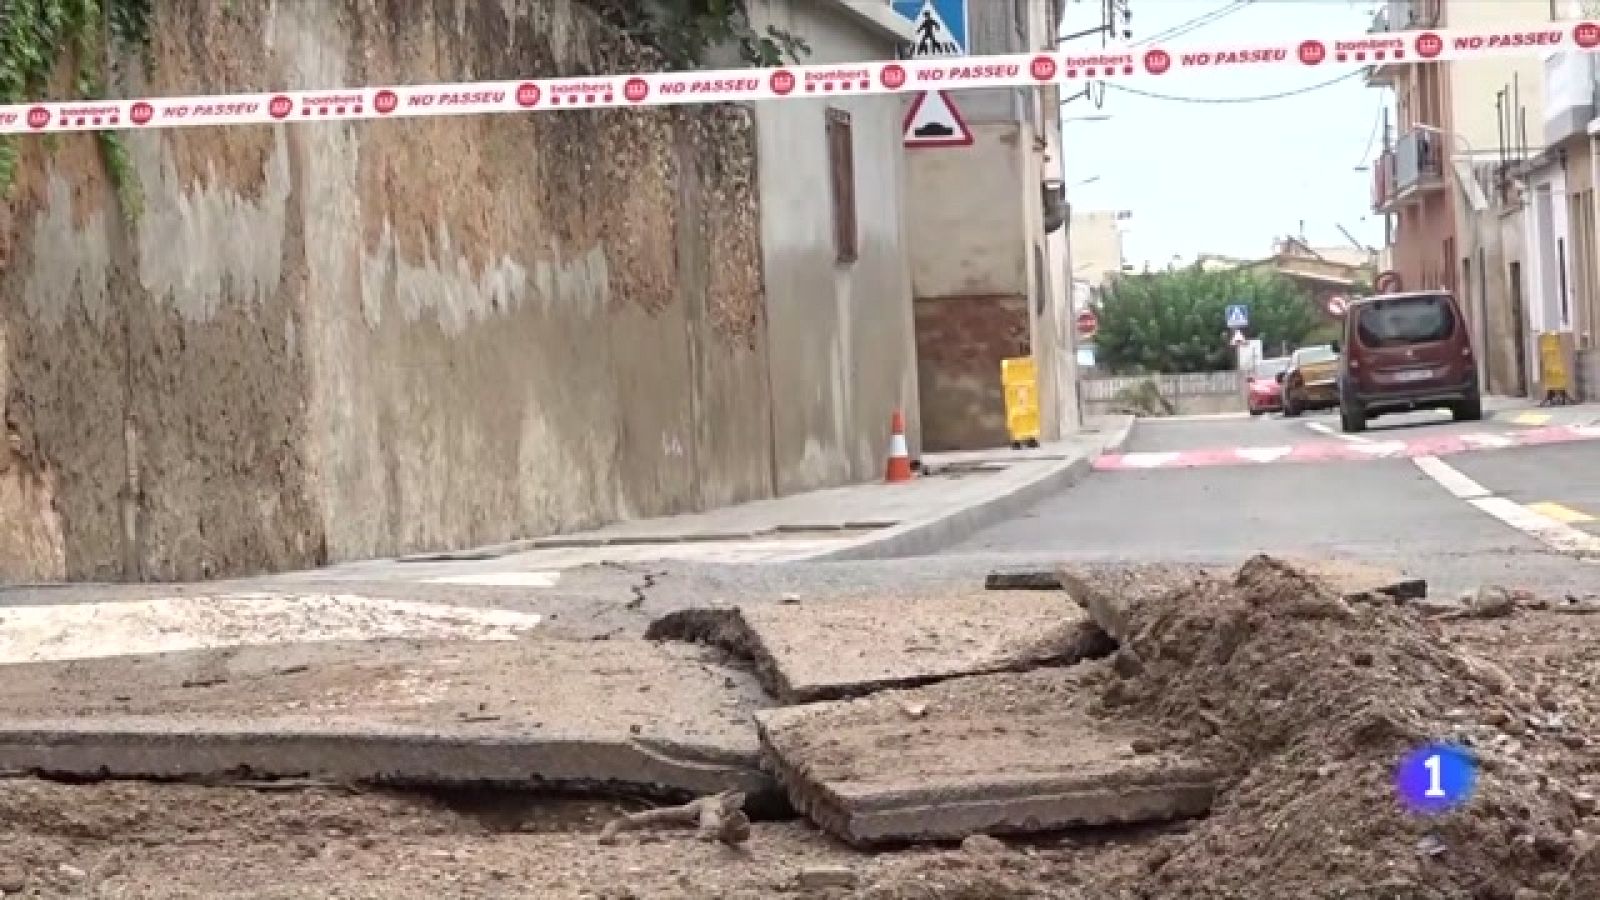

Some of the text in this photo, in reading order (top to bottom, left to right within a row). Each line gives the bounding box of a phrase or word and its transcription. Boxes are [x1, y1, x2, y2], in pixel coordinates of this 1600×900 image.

[1454, 37, 1482, 50] NO
[1487, 32, 1563, 48] PASSEU
[1067, 54, 1133, 67] bombers
[1182, 53, 1210, 65] NO
[1215, 50, 1286, 65] PASSEU
[805, 69, 870, 81] bombers
[917, 65, 1019, 80] NO PASSEU
[660, 82, 686, 93] NO
[690, 79, 760, 92] PASSEU
[408, 95, 435, 106] NO
[438, 92, 505, 105] PASSEU
[164, 107, 189, 117] NO
[193, 103, 259, 115] PASSEU
